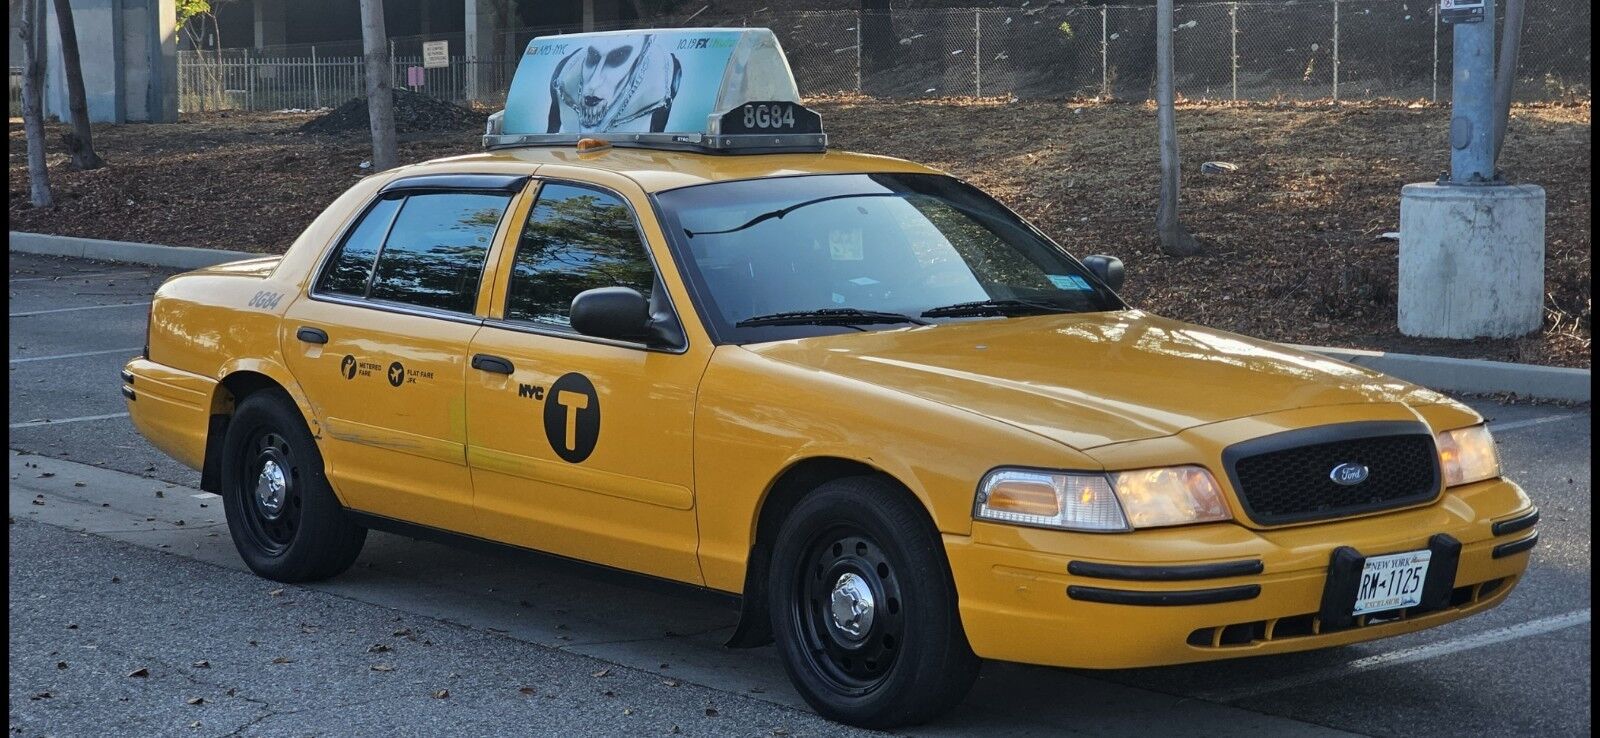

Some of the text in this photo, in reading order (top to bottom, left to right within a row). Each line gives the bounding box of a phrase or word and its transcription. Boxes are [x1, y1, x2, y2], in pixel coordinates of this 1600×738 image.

[743, 104, 796, 129] 8G84
[248, 290, 286, 310] 8G84
[359, 369, 371, 377] FARE
[360, 362, 382, 372] METERED
[407, 369, 434, 380] FLAT FARE
[518, 383, 545, 401] NYC
[557, 389, 589, 452] T
[1341, 467, 1361, 481] Ford
[1371, 557, 1411, 571] NEW YORK
